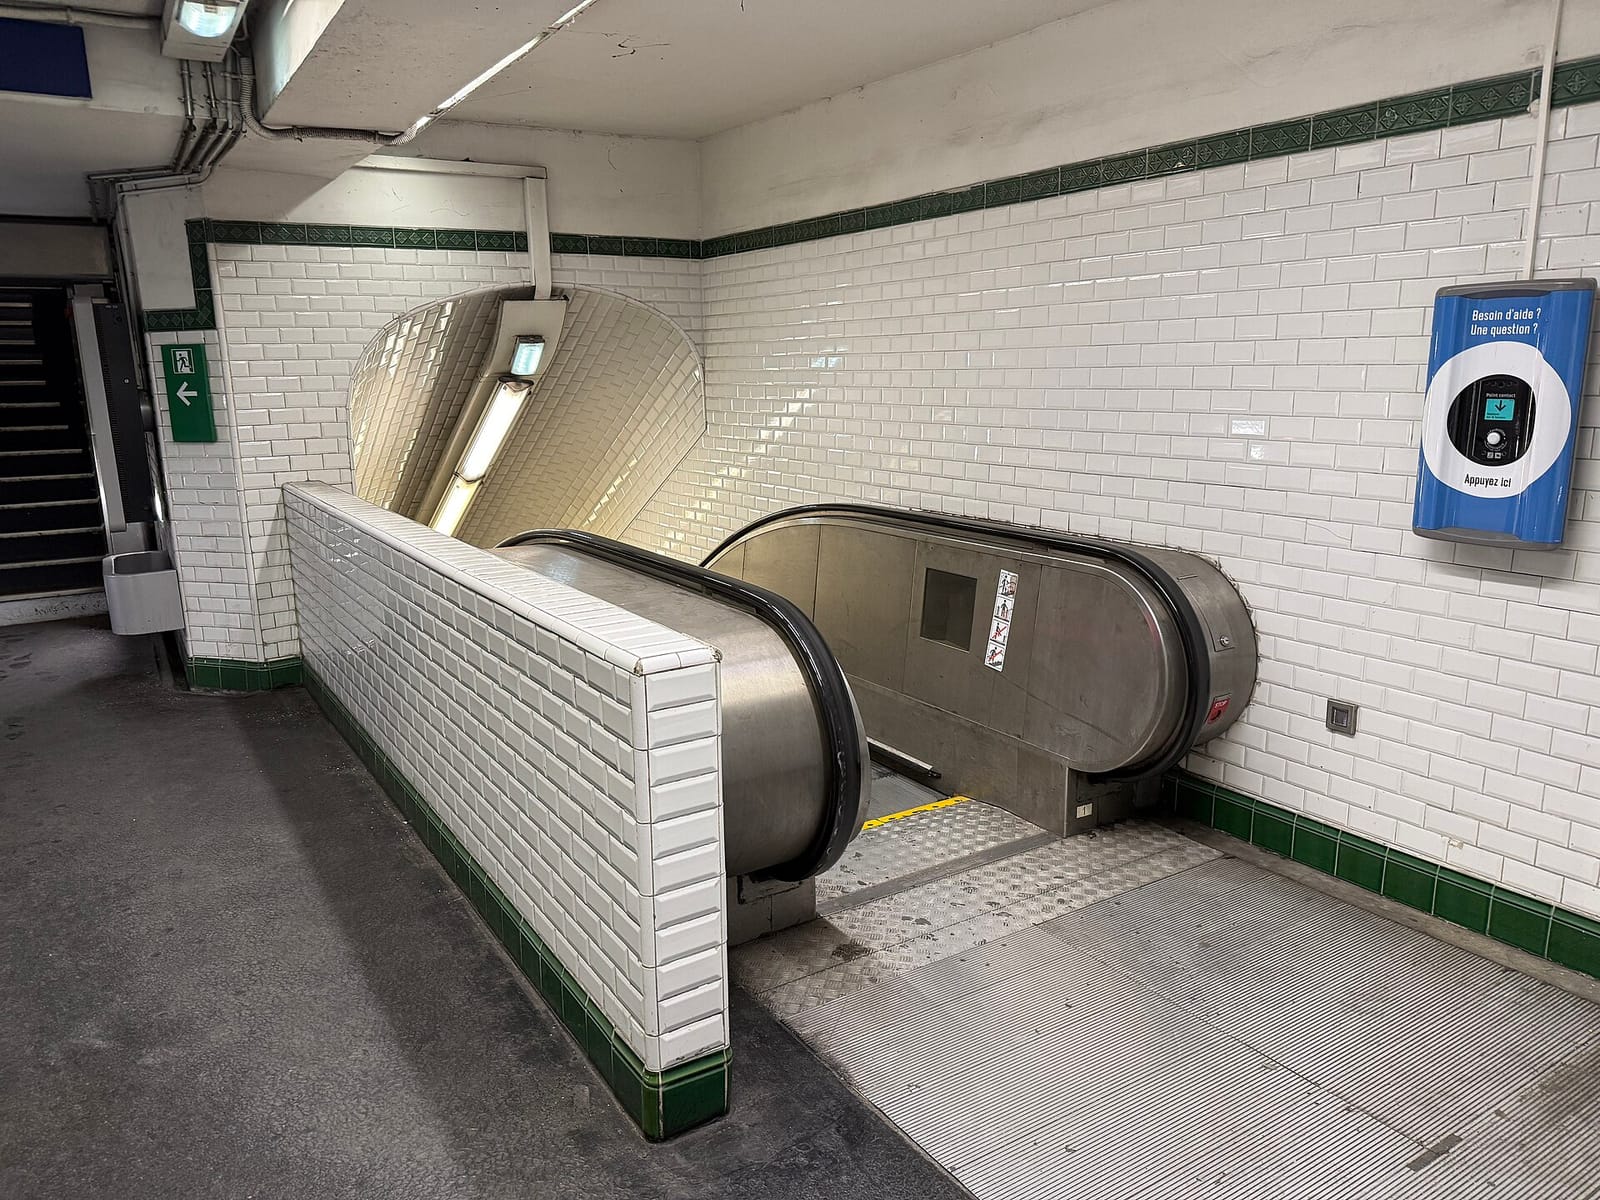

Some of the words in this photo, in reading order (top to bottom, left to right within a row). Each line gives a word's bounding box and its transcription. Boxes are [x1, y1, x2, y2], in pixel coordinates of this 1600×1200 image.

[1472, 309, 1503, 321] Besoin
[1505, 308, 1534, 320] d'aide
[1536, 307, 1542, 319] ?
[1470, 324, 1488, 336] Une
[1490, 323, 1530, 338] question
[1533, 322, 1539, 335] ?
[1464, 473, 1499, 489] Appuyez
[1500, 477, 1512, 488] ici
